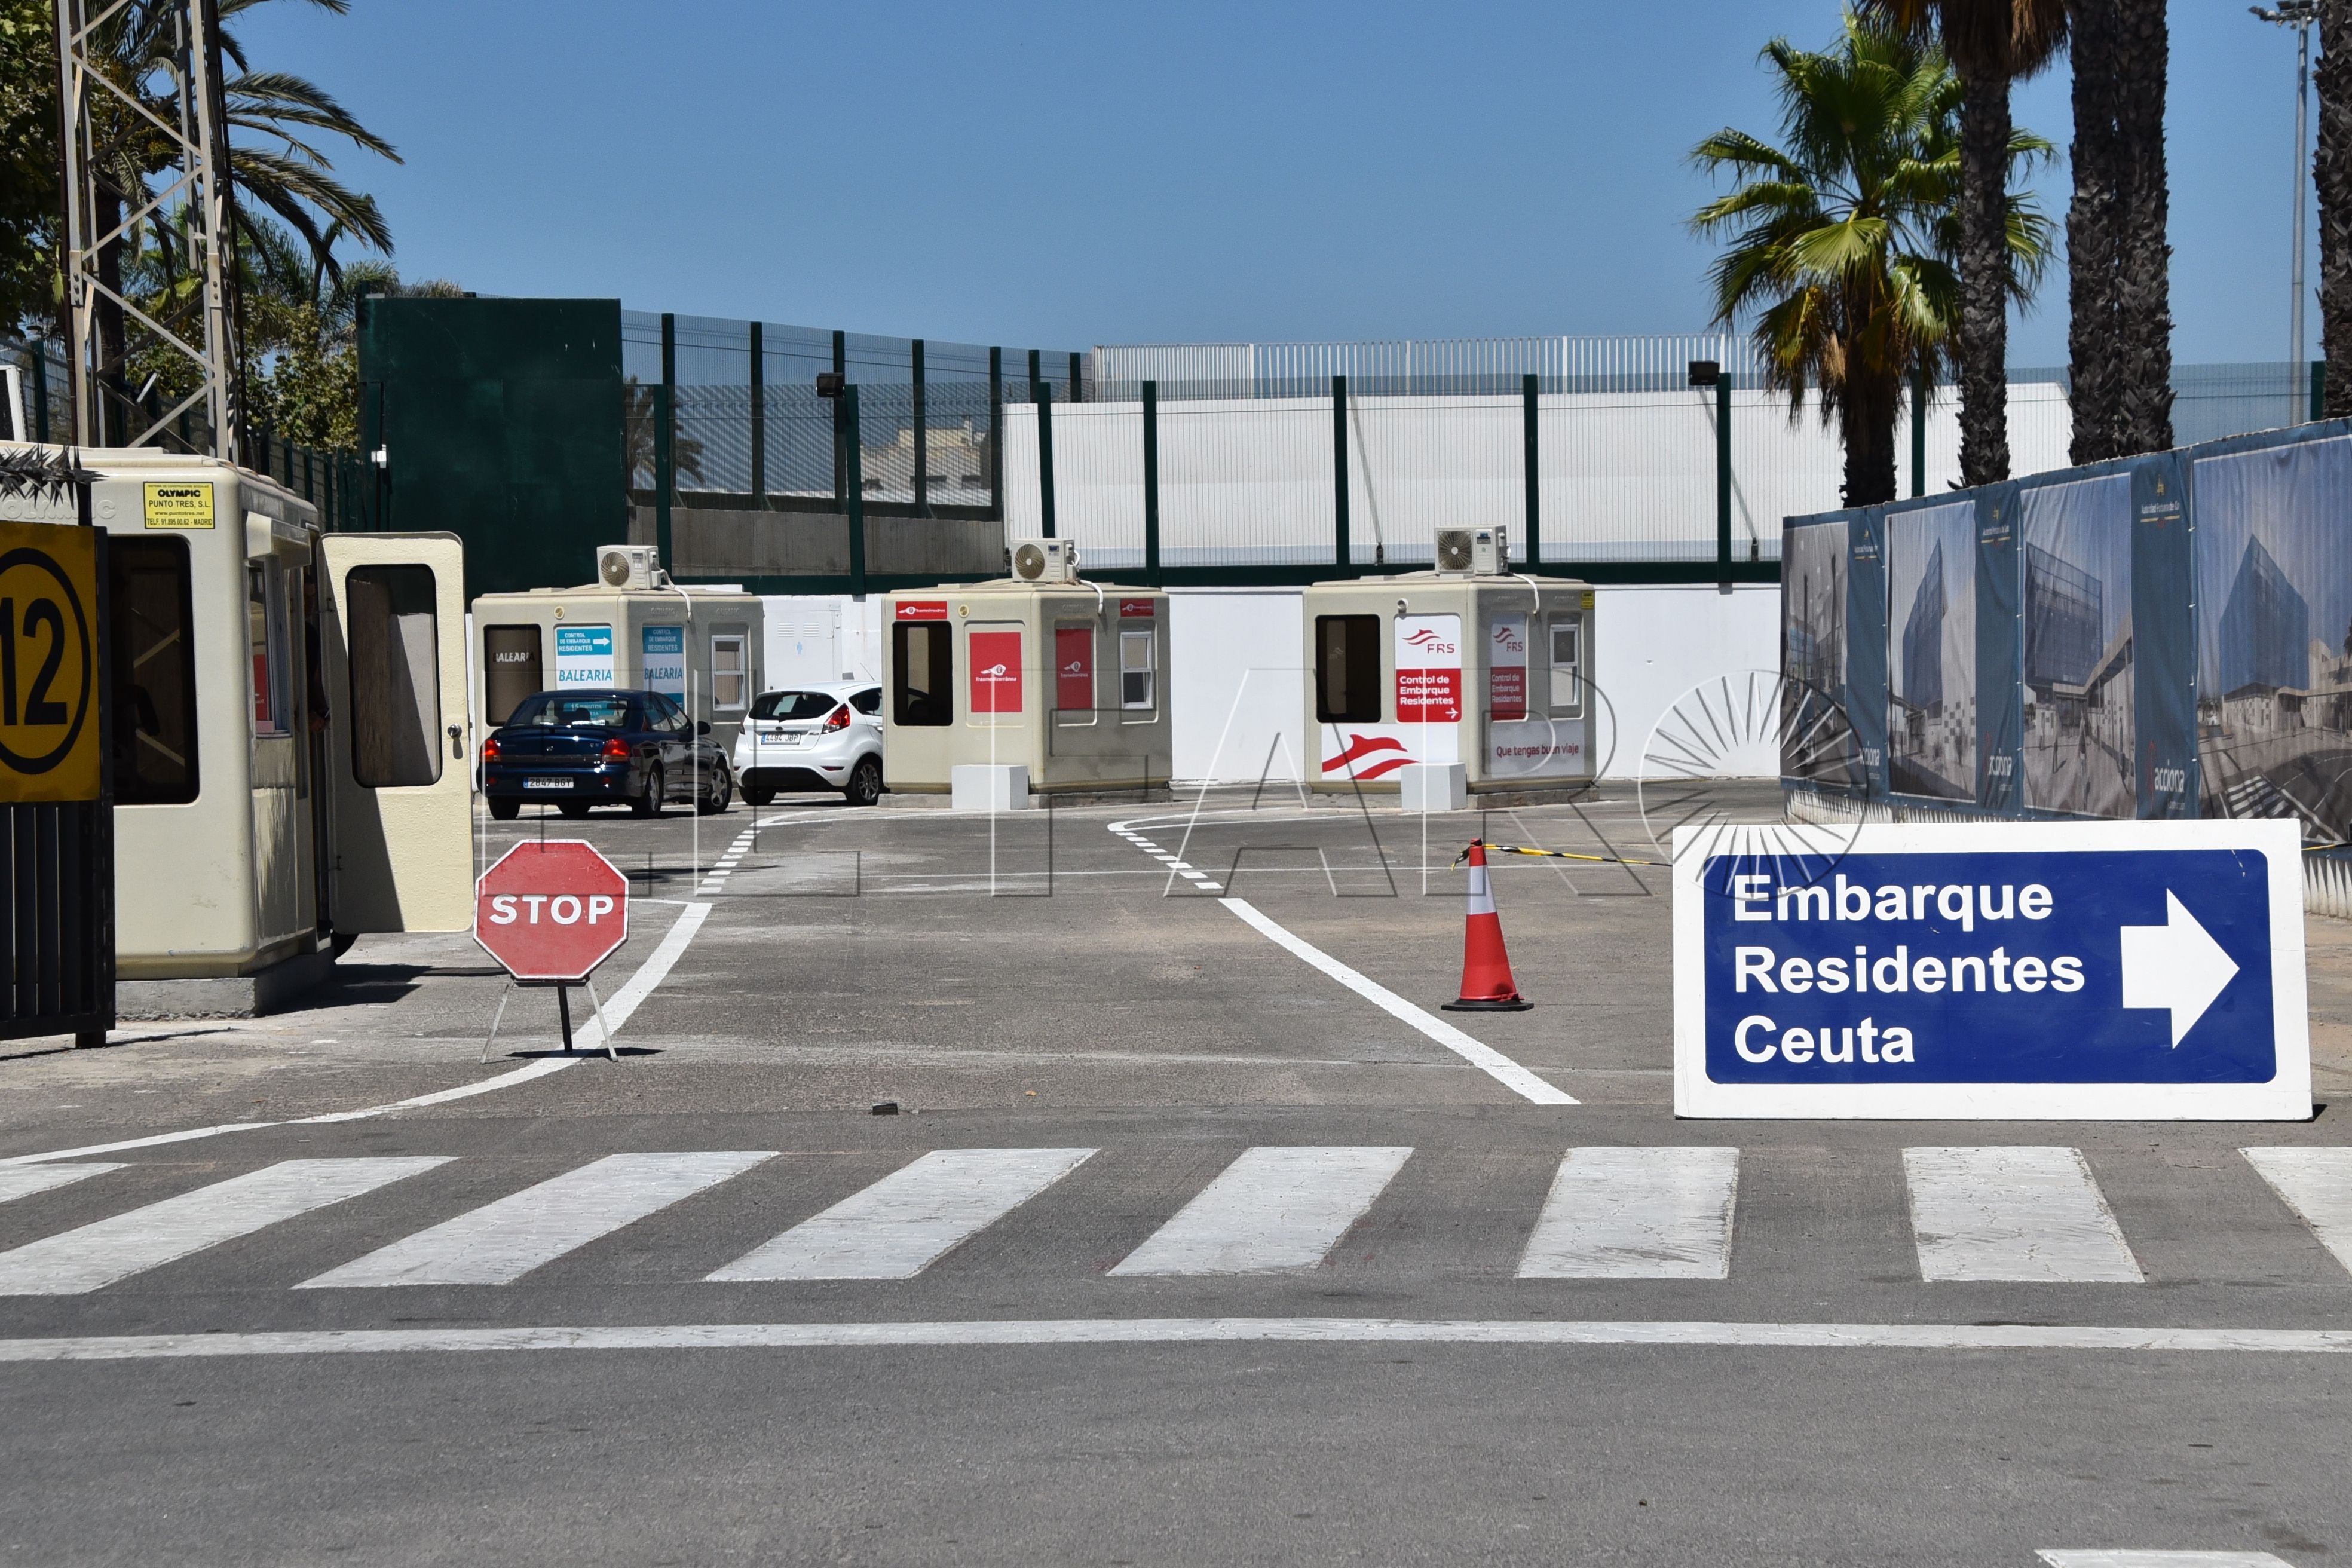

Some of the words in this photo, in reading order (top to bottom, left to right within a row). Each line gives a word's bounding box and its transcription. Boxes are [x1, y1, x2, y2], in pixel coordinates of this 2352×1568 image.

[157, 489, 201, 498] OLYMPIC
[175, 500, 197, 509] TRES,
[1427, 643, 1455, 654] FRS
[1506, 641, 1523, 652] FRS
[0, 596, 68, 726] 12
[1399, 676, 1435, 684] Control
[1437, 675, 1450, 684] de
[1492, 673, 1511, 682] Control
[1512, 673, 1520, 682] de
[1399, 686, 1450, 696] Embarque
[1492, 684, 1520, 693] Embarque
[1399, 696, 1454, 705] Residentes
[1492, 694, 1523, 703] Residentes
[1496, 745, 1512, 758] Que
[1514, 746, 1541, 758] tengas
[1541, 744, 1561, 755] buen
[1561, 743, 1579, 755] viaje
[2154, 758, 2185, 793] acciona
[529, 778, 553, 787] 2847
[555, 778, 574, 787] BGY
[1734, 874, 2053, 932] Embarque
[489, 894, 614, 925] STOP
[1735, 945, 2085, 993] Residentes
[1734, 1015, 1915, 1064] Ceuta
